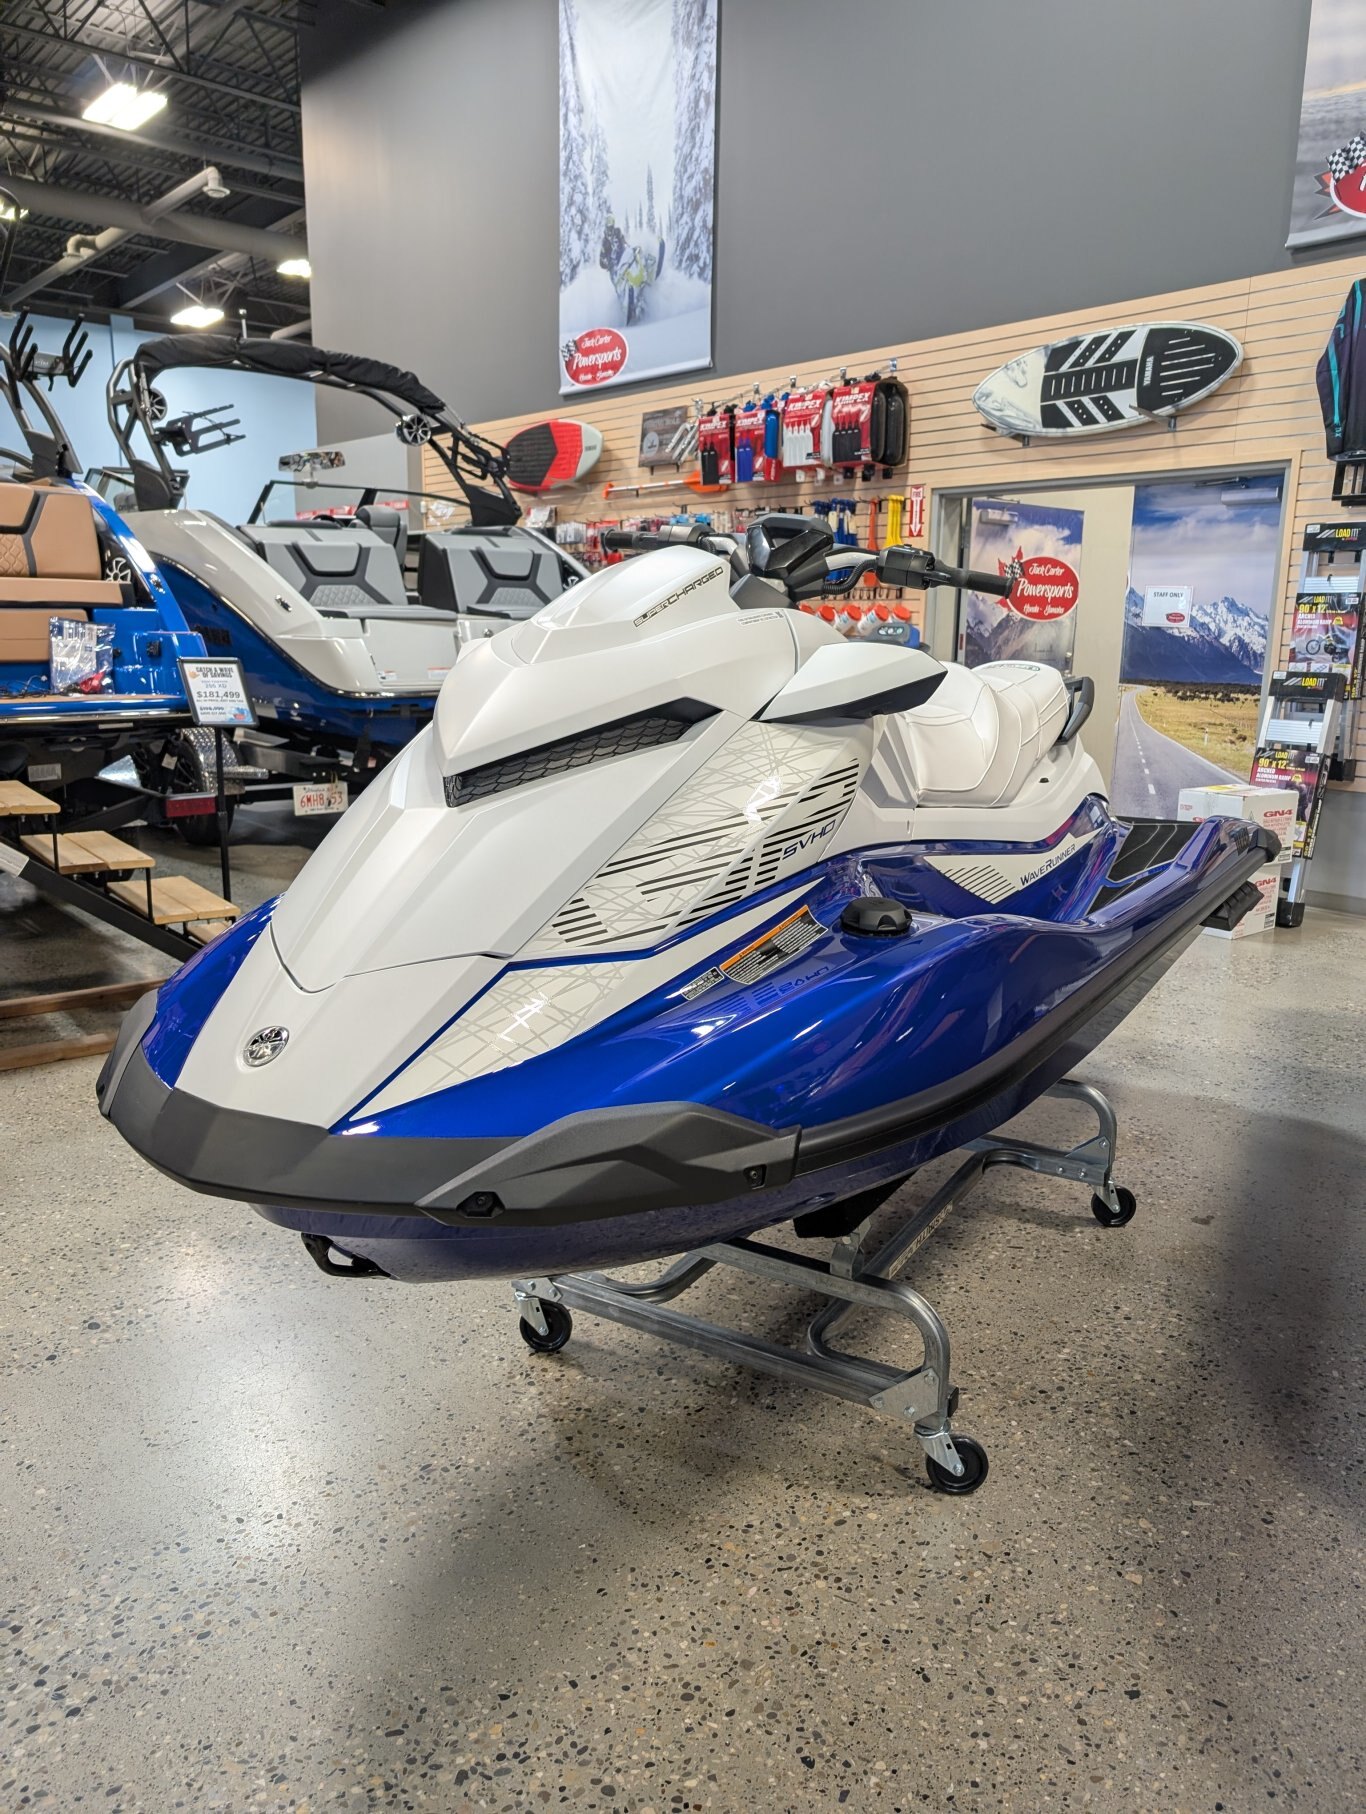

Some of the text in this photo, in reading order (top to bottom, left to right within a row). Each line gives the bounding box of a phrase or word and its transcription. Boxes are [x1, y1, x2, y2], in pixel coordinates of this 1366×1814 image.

[572, 346, 622, 370] Powersports
[1143, 356, 1154, 386] YAMAHA
[787, 398, 822, 412] KIMPEX
[834, 392, 872, 406] KIMPEX
[1335, 528, 1350, 538] LOAD
[1029, 563, 1064, 576] Jack Carter
[633, 566, 724, 627] SUPERCHARGED
[1017, 578, 1073, 603] Powersports
[1302, 678, 1317, 686] LOAD
[196, 691, 240, 699] $181,499
[1264, 809, 1293, 817] GN4
[782, 819, 836, 860] SVHO
[1256, 877, 1276, 887] GN4
